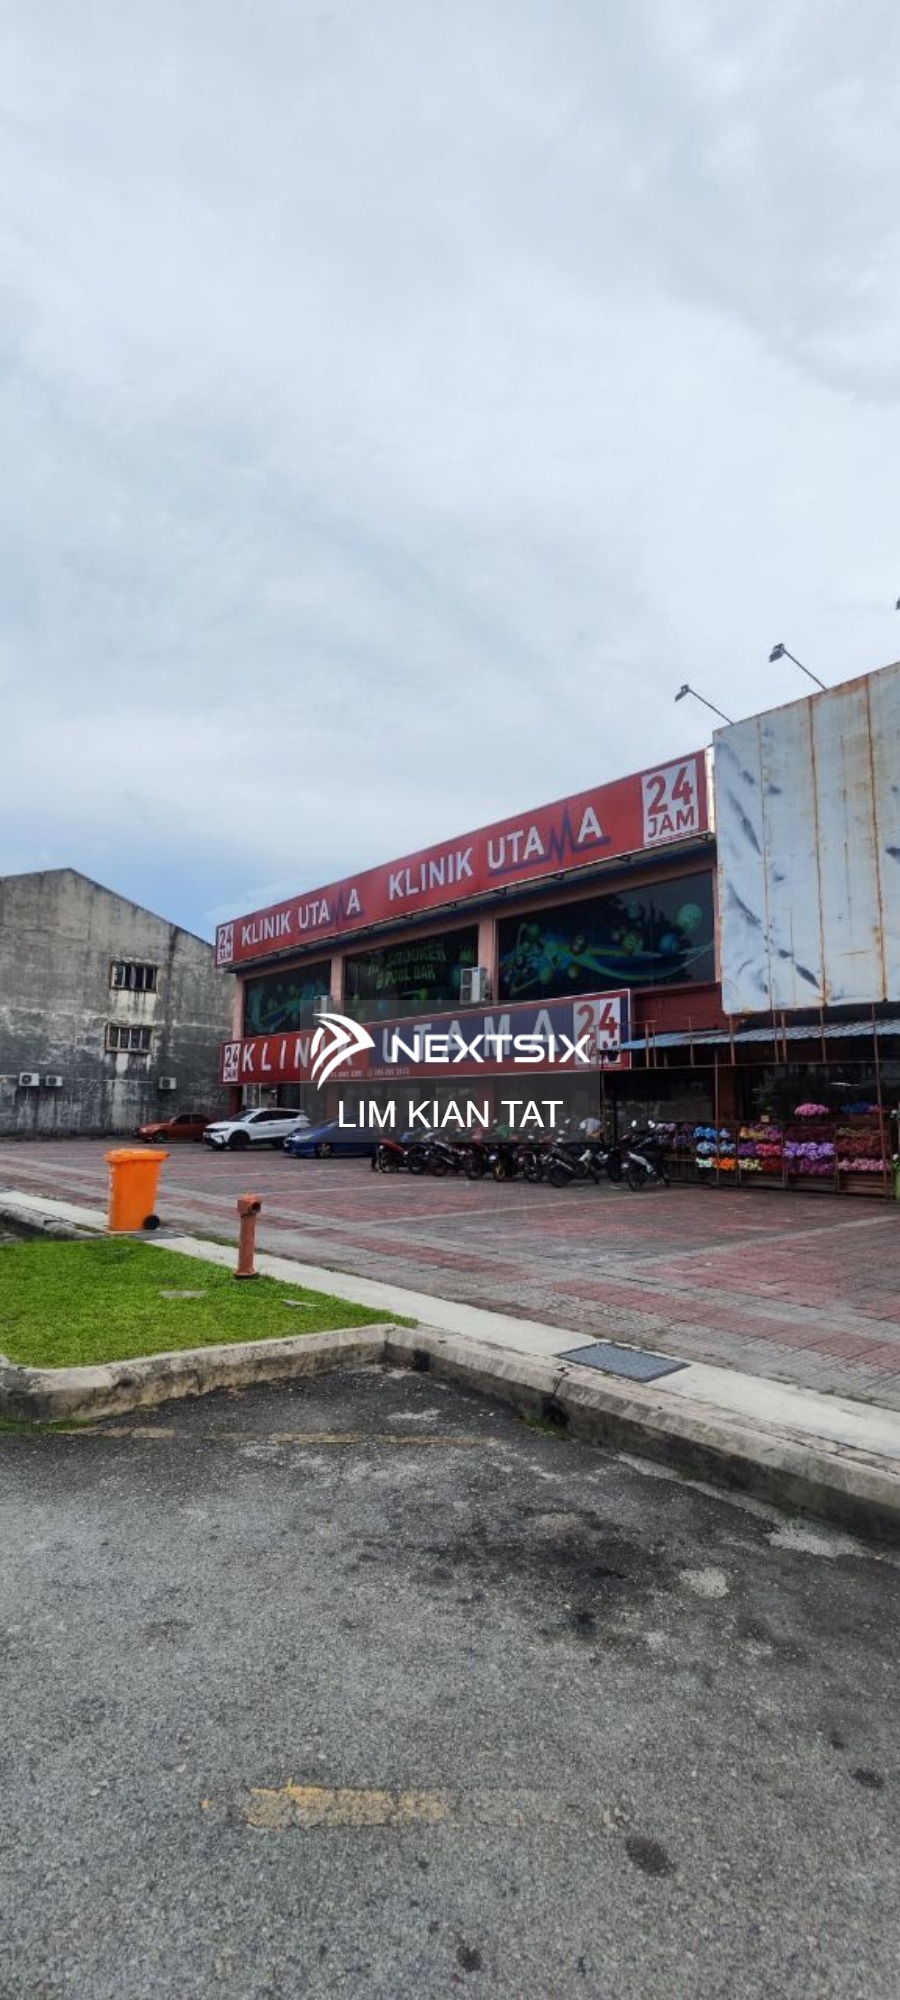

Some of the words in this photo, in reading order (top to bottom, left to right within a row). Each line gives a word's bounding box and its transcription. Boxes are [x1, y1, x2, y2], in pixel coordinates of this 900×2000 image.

[646, 764, 693, 817] 24
[648, 805, 695, 838] JAM
[389, 845, 473, 901] KLINIK
[487, 805, 603, 870] UTAMA
[219, 925, 232, 950] 24
[241, 909, 292, 947] KLINIK
[297, 888, 361, 931] UTAMA
[382, 1008, 560, 1063] UTAMA
[576, 1002, 618, 1041] 24
[225, 1044, 239, 1068] 24
